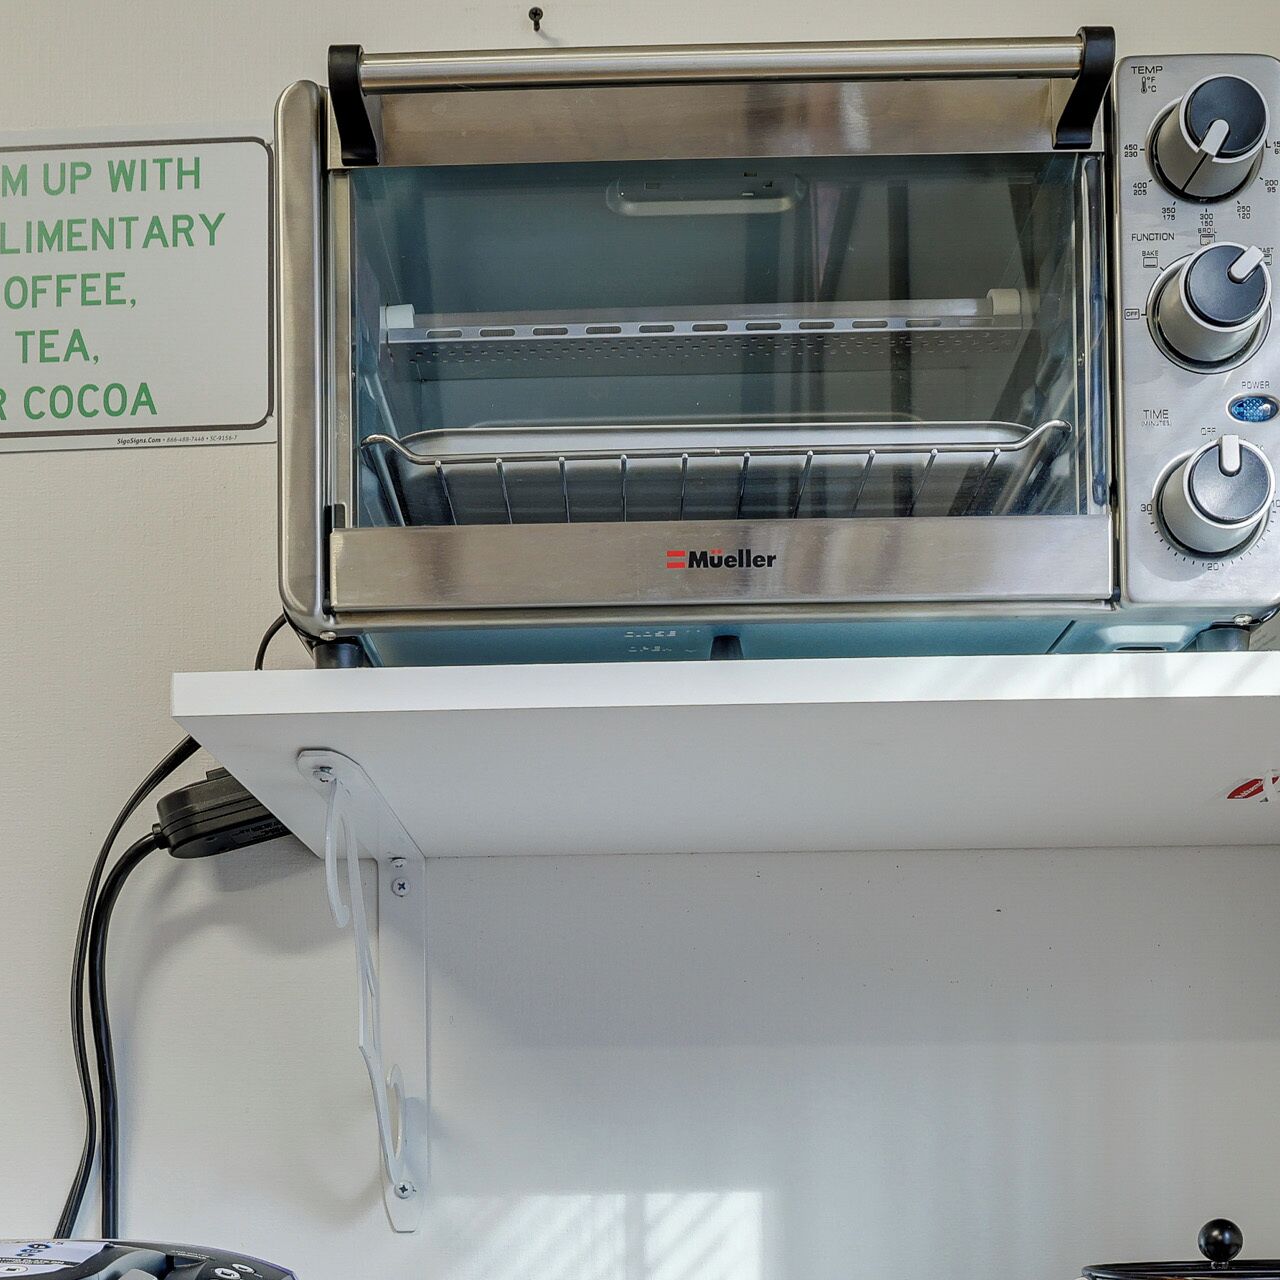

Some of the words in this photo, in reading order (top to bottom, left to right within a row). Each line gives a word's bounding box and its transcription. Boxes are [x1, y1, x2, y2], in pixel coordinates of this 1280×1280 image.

[1131, 66, 1163, 74] TEMP
[42, 161, 92, 197] UP
[108, 156, 201, 193] WITH
[1131, 233, 1175, 241] FUNCTION
[14, 328, 99, 365] TEA,
[1241, 381, 1270, 389] POWER
[23, 382, 158, 420] COCOA
[1143, 409, 1169, 419] TIME
[1201, 427, 1216, 435] OFF
[1140, 504, 1153, 512] 30
[1207, 563, 1219, 571] 20
